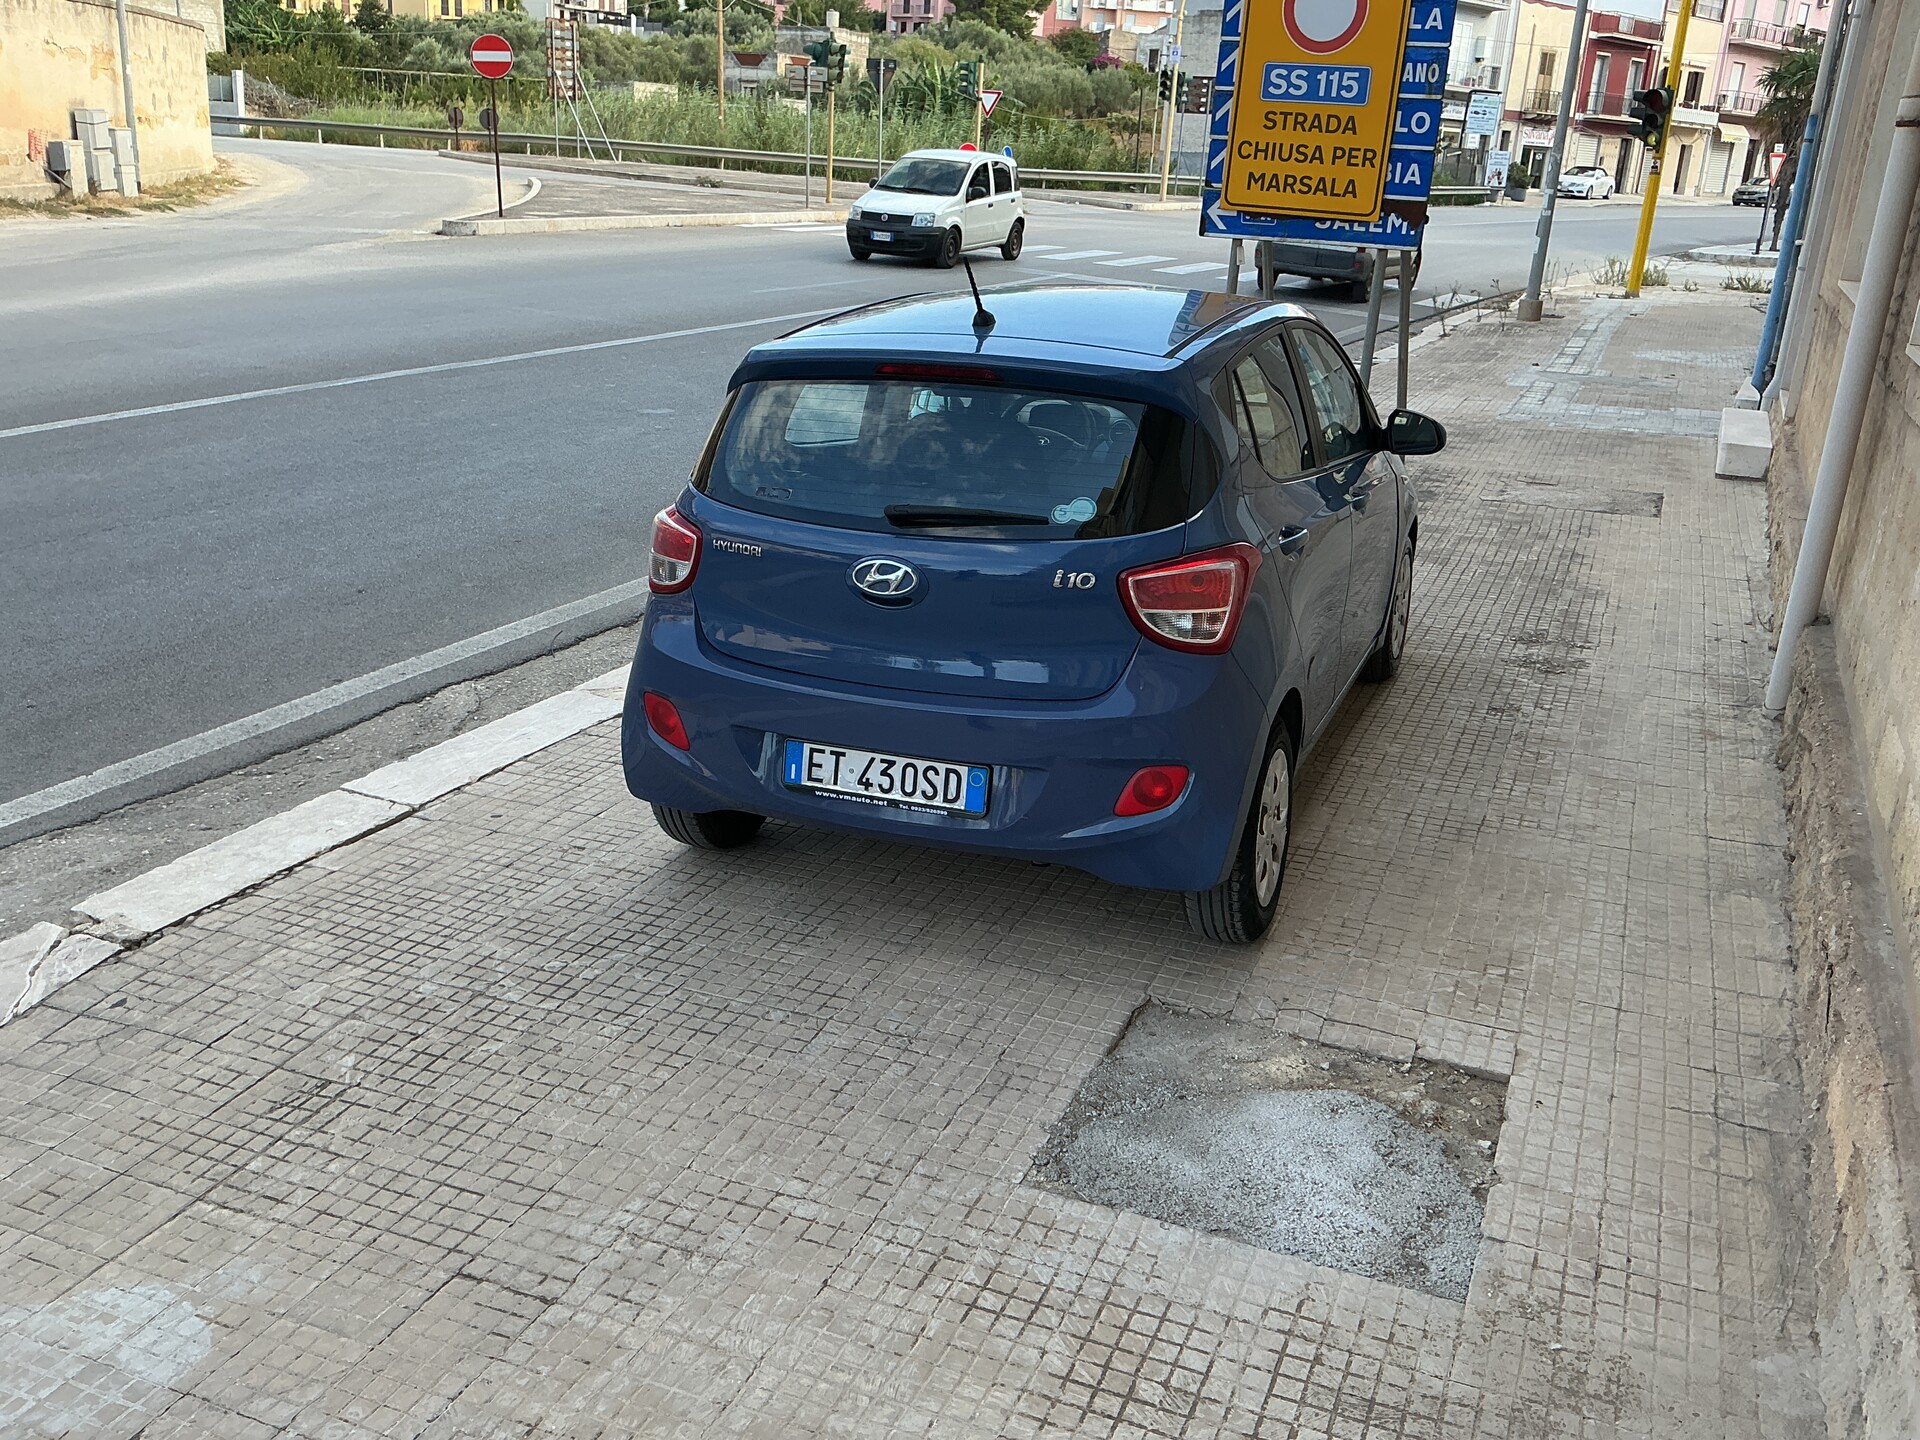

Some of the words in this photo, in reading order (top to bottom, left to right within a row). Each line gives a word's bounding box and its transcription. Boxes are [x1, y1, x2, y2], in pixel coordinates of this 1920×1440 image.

[1267, 68, 1308, 96] SS
[1317, 70, 1361, 99] 115
[1262, 110, 1358, 136] STRADA
[1237, 140, 1324, 165] CHIUSA
[1331, 147, 1377, 169] PER
[1246, 171, 1358, 199] MARSALA
[1314, 211, 1415, 236] ALEM
[712, 538, 762, 558] HYUNDAI
[806, 746, 847, 787] ET
[856, 756, 963, 805] 430SD
[815, 790, 888, 806] www.vmauto.net
